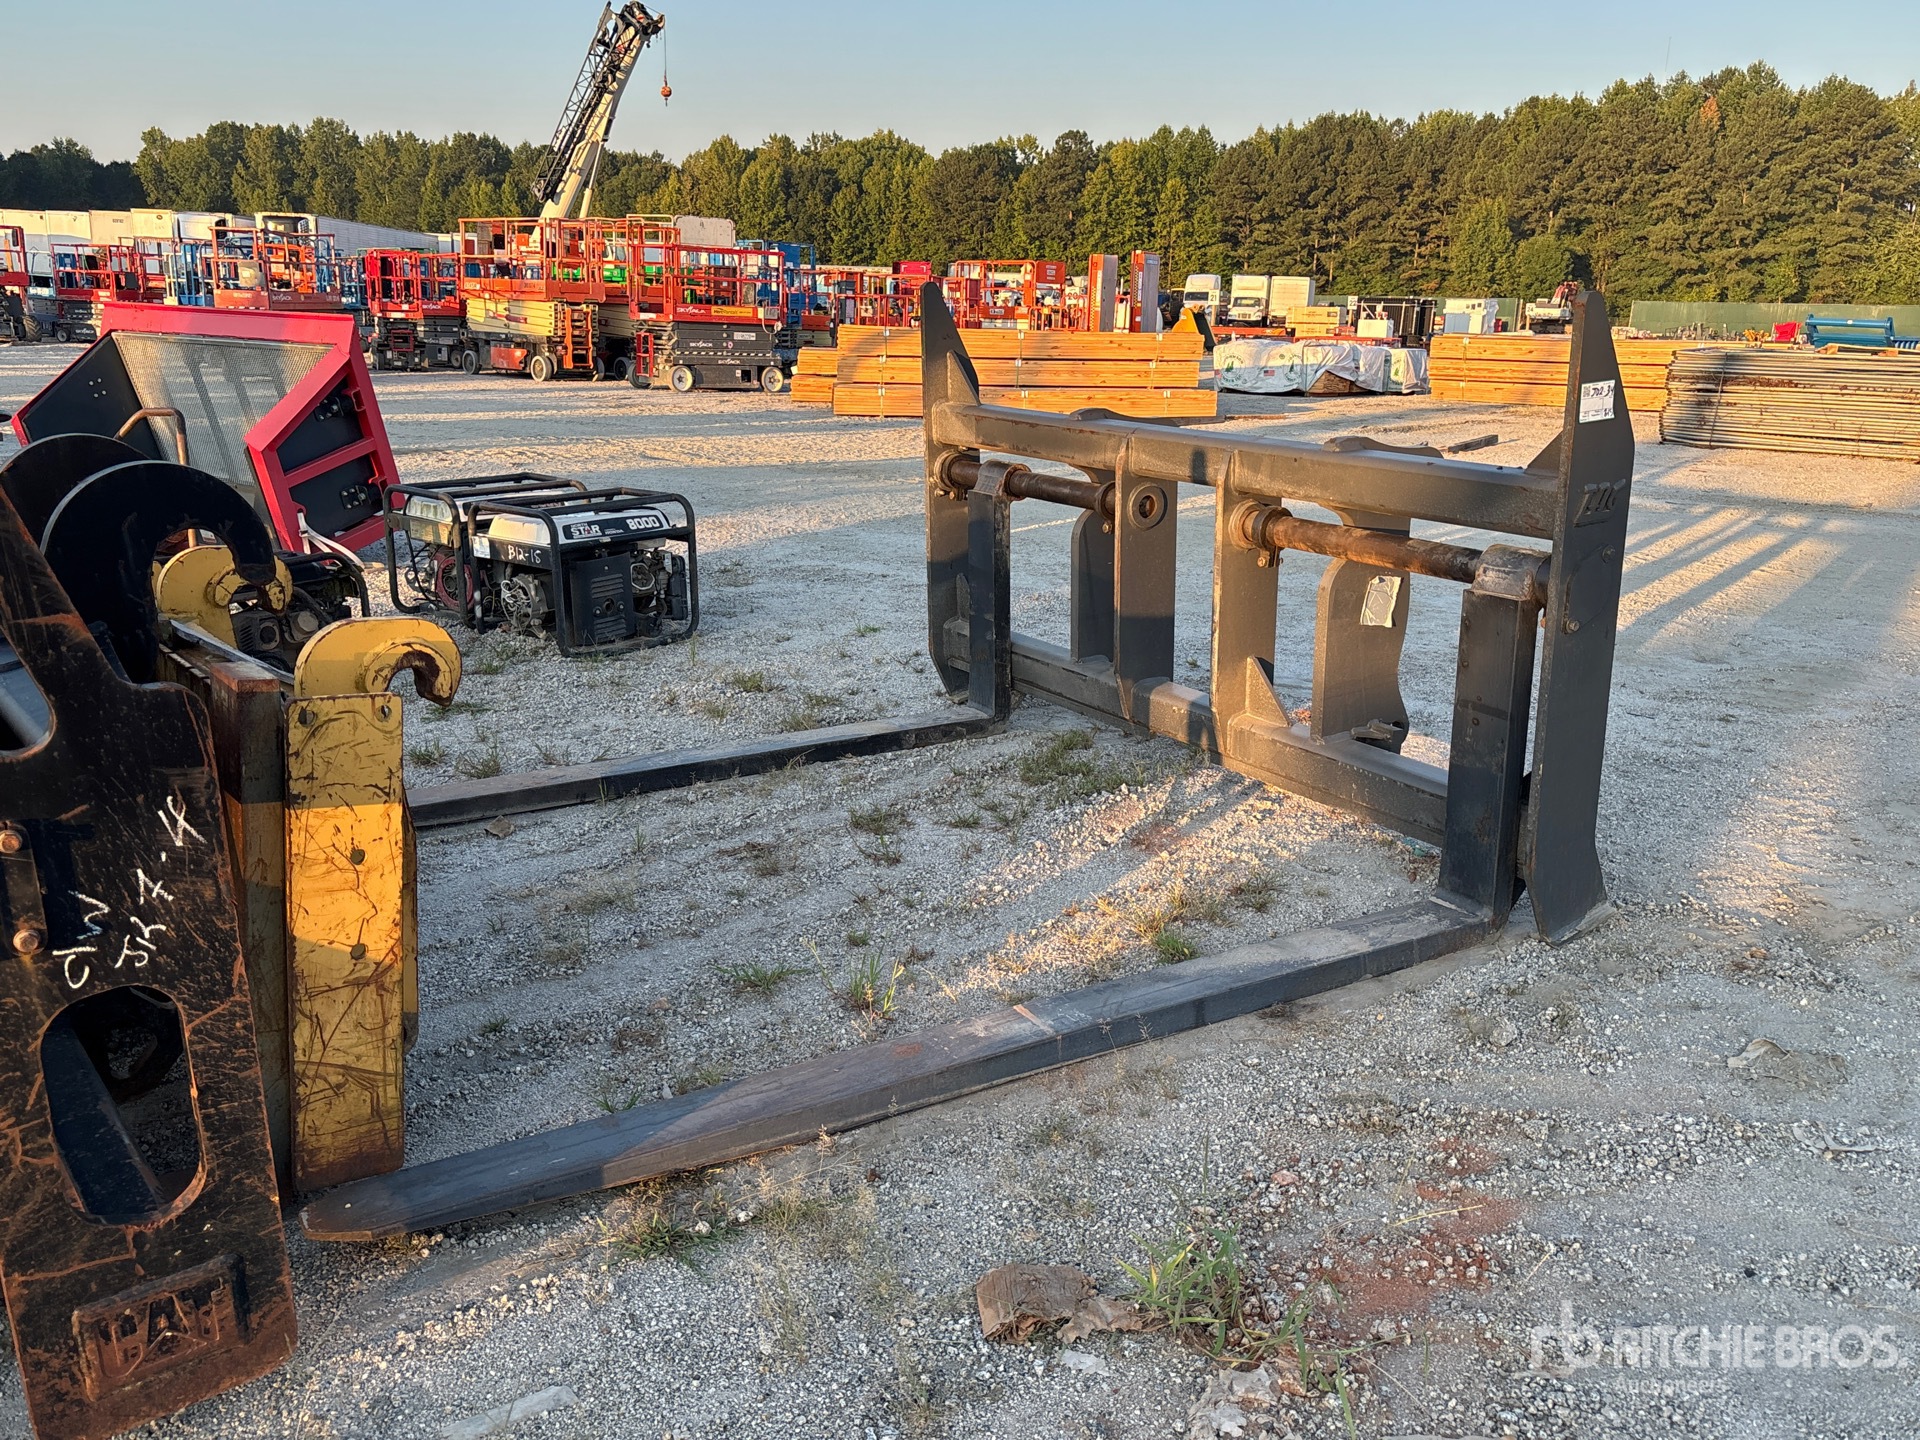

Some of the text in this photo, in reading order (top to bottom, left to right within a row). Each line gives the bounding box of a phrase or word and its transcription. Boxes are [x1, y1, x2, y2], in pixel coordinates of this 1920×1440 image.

[1210, 294, 1217, 302] 21
[626, 516, 660, 530] 8000
[571, 524, 601, 536] STAR
[97, 1276, 226, 1379] CAT
